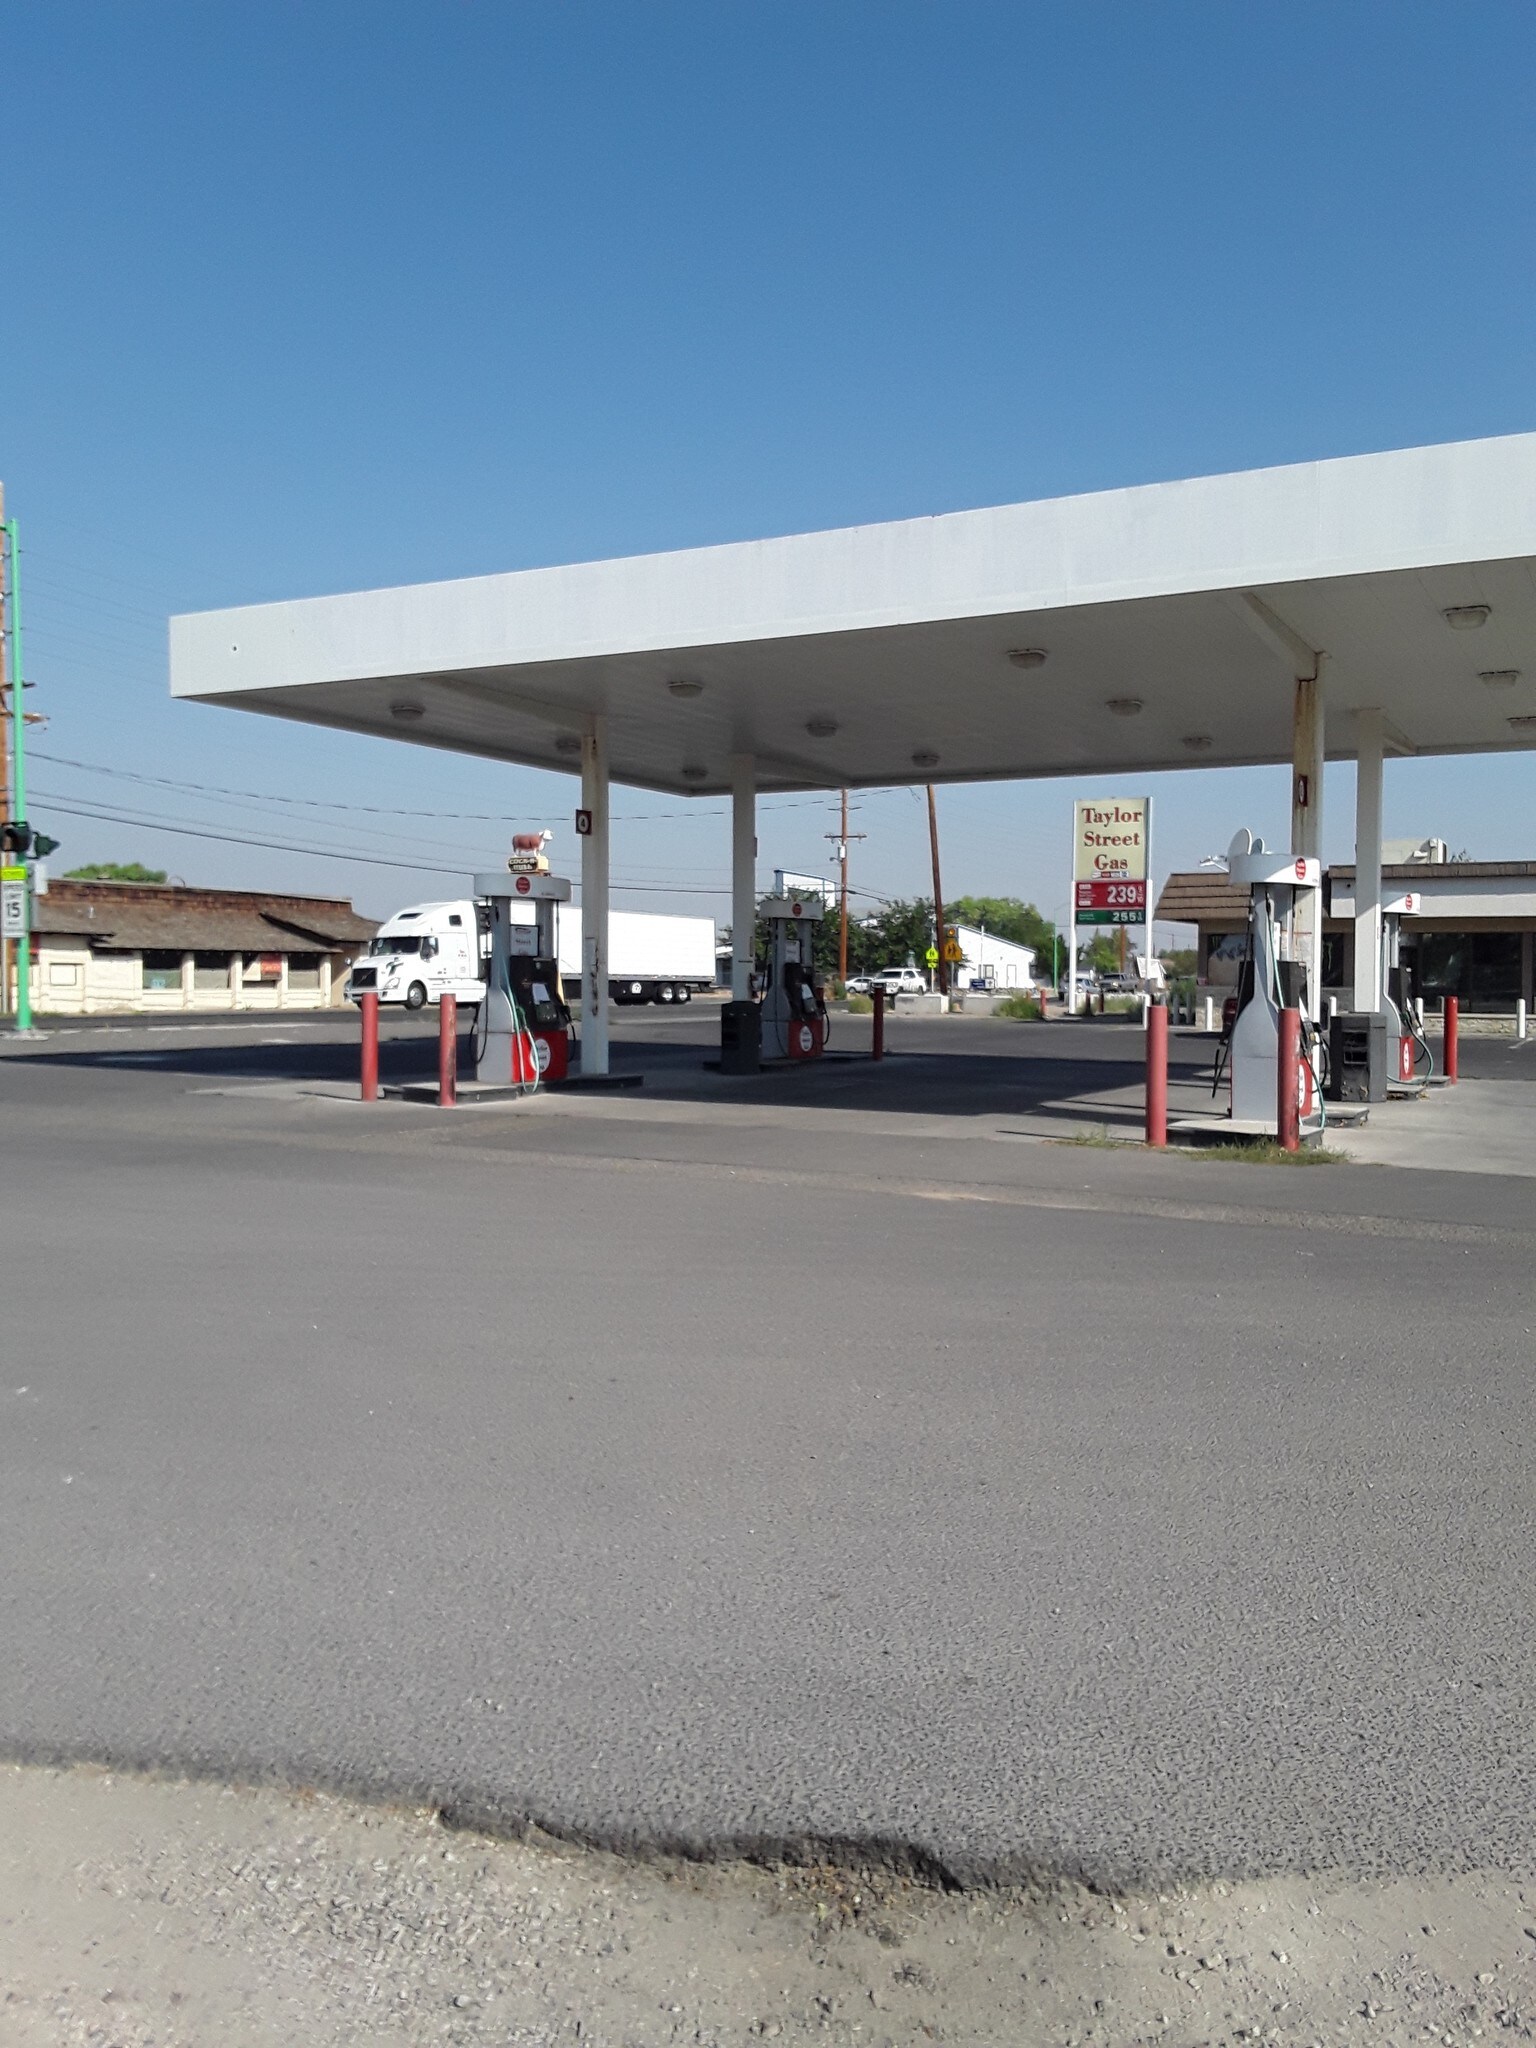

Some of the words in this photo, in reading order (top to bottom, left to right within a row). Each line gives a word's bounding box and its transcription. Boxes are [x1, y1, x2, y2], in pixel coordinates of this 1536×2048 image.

[1081, 806, 1142, 828] Taylor
[1084, 831, 1140, 847] Street
[1094, 854, 1128, 871] Gas
[1107, 886, 1136, 904] 239
[6, 902, 20, 918] 15
[1112, 911, 1137, 922] 255
